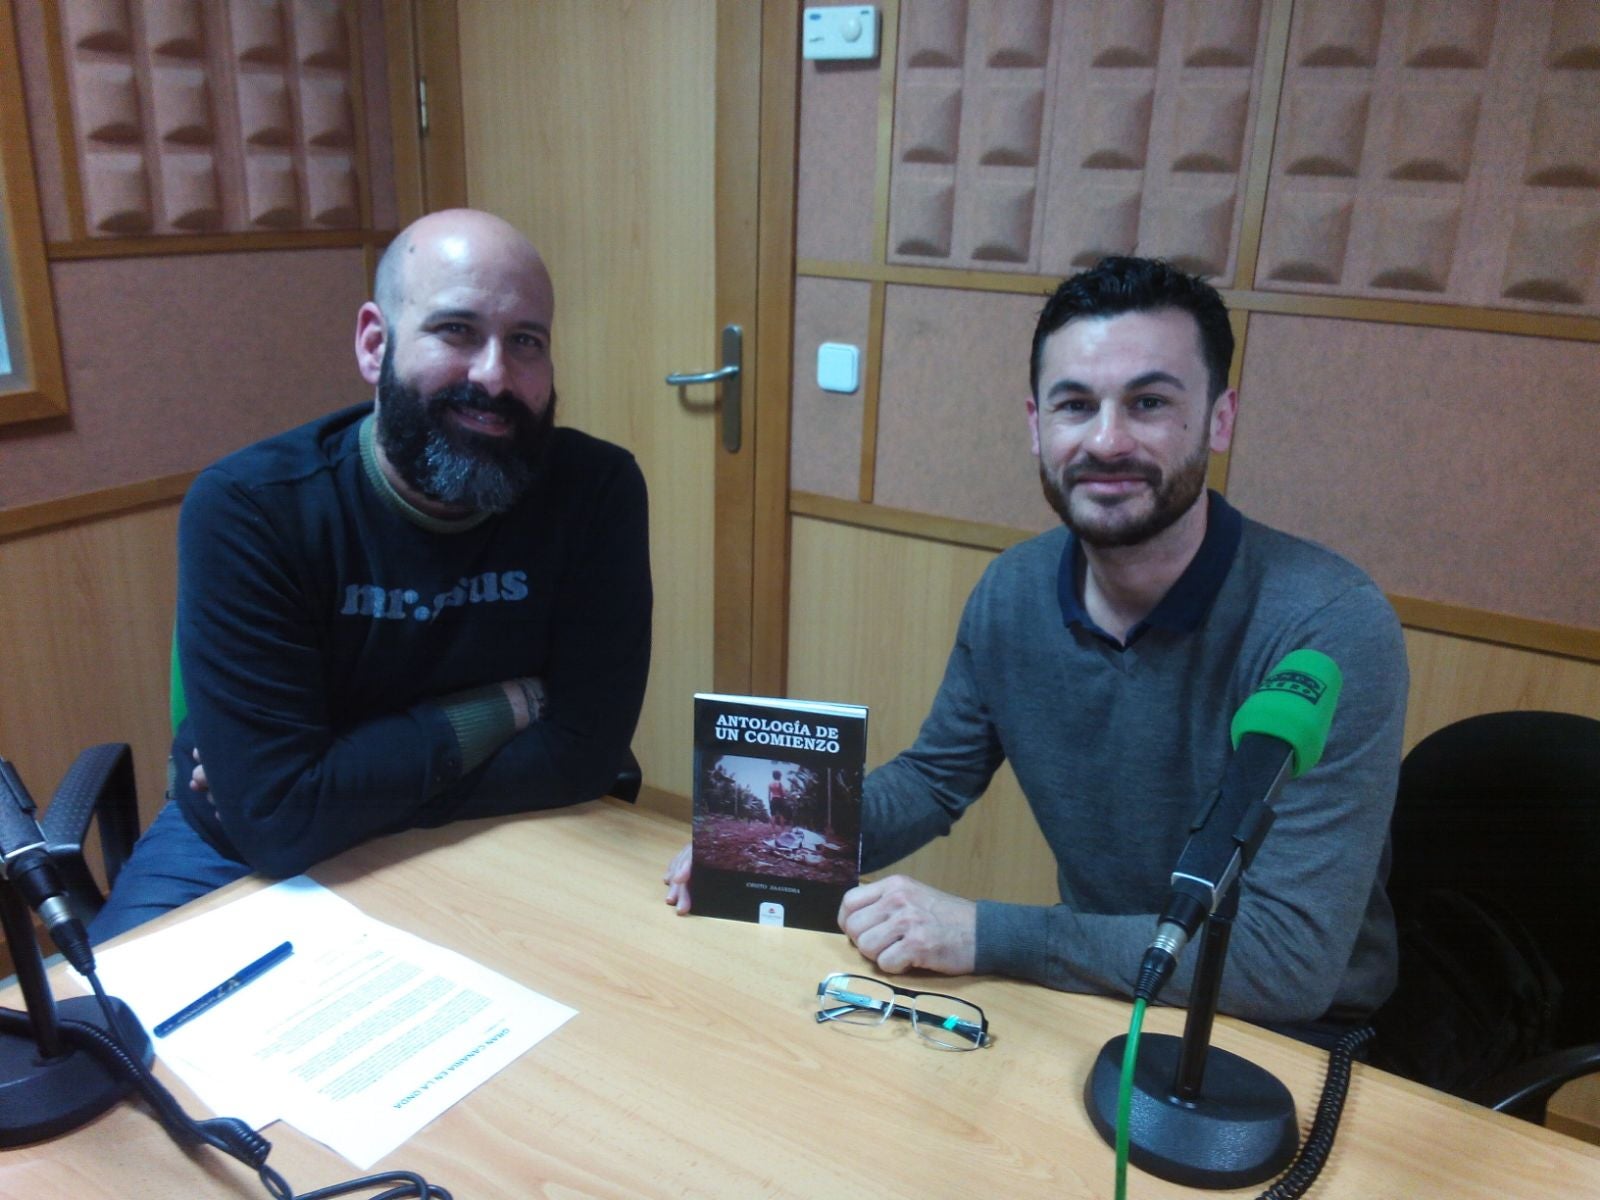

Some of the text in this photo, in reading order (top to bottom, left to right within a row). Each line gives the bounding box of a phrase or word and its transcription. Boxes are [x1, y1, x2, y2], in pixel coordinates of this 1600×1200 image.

[716, 714, 839, 739] ANTOLOGÍA DE
[715, 727, 840, 753] UN COMIENZO
[392, 1027, 510, 1109] GRAN CANARIA EN LA ONDA
